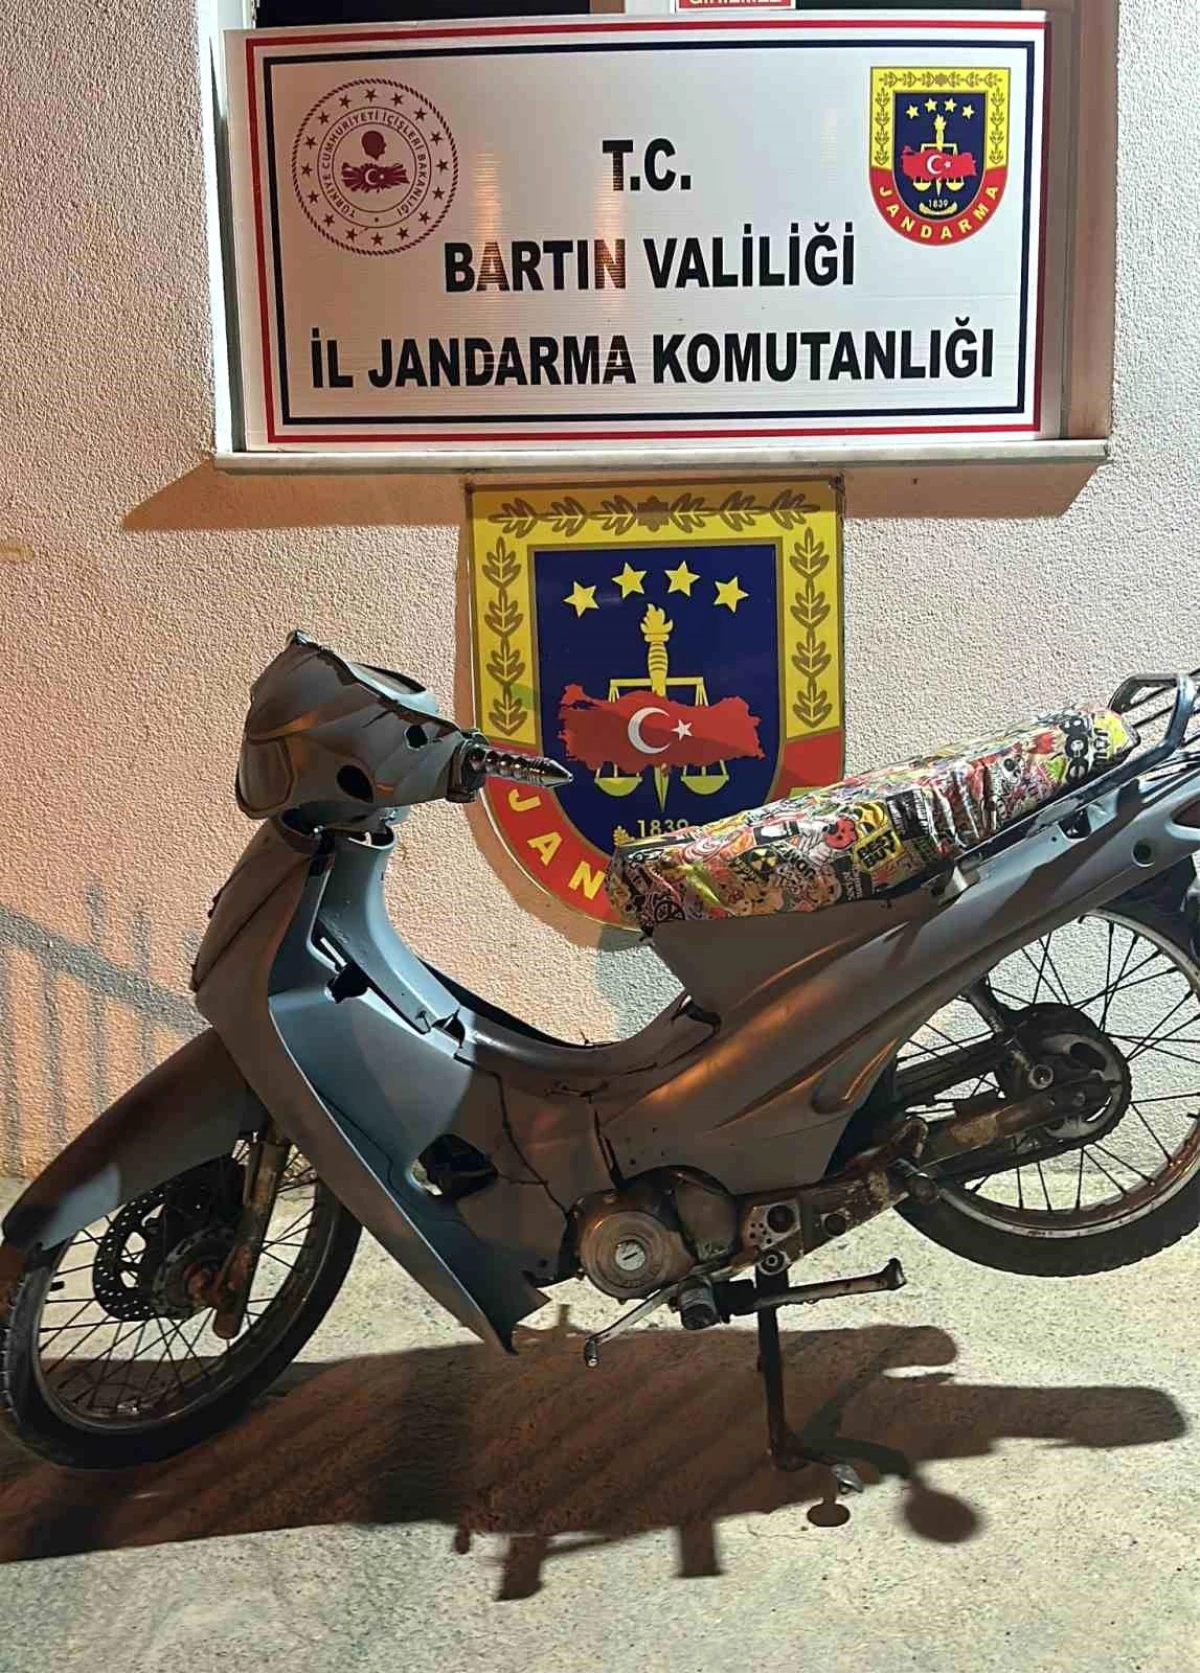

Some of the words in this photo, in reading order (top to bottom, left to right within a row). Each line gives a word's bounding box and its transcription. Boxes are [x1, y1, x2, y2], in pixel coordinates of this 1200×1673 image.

[602, 138, 692, 191] T.C.
[879, 185, 999, 240] JANDARMA
[928, 199, 949, 208] 1839
[444, 239, 626, 292] BARTIN
[643, 222, 854, 288] VALİLİĞİ
[311, 327, 353, 388] İL
[368, 335, 636, 388] JANDARMA
[653, 316, 994, 383] KOMUTANLIĞI
